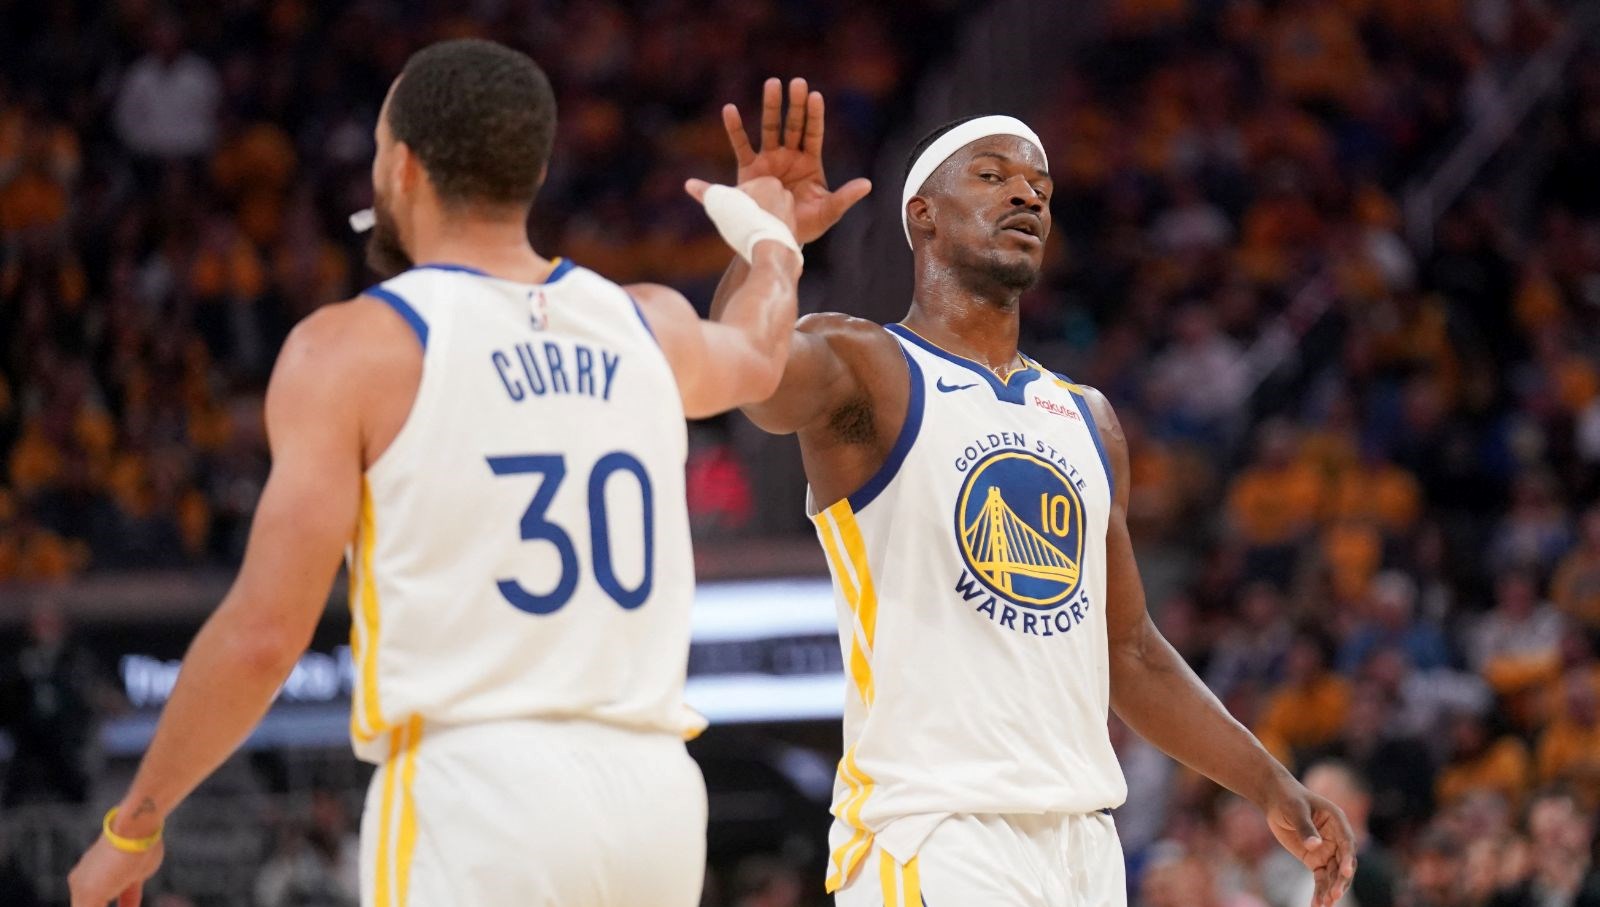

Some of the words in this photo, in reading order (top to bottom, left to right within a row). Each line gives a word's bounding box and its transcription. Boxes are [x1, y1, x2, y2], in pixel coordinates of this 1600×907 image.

[491, 341, 620, 402] CURRY
[1034, 396, 1080, 421] Rakuten
[955, 431, 1026, 473] GOLDEN
[1036, 439, 1087, 494] STATE
[485, 451, 653, 615] 30
[1040, 492, 1071, 538] 10
[955, 569, 1090, 636] WARRIORS
